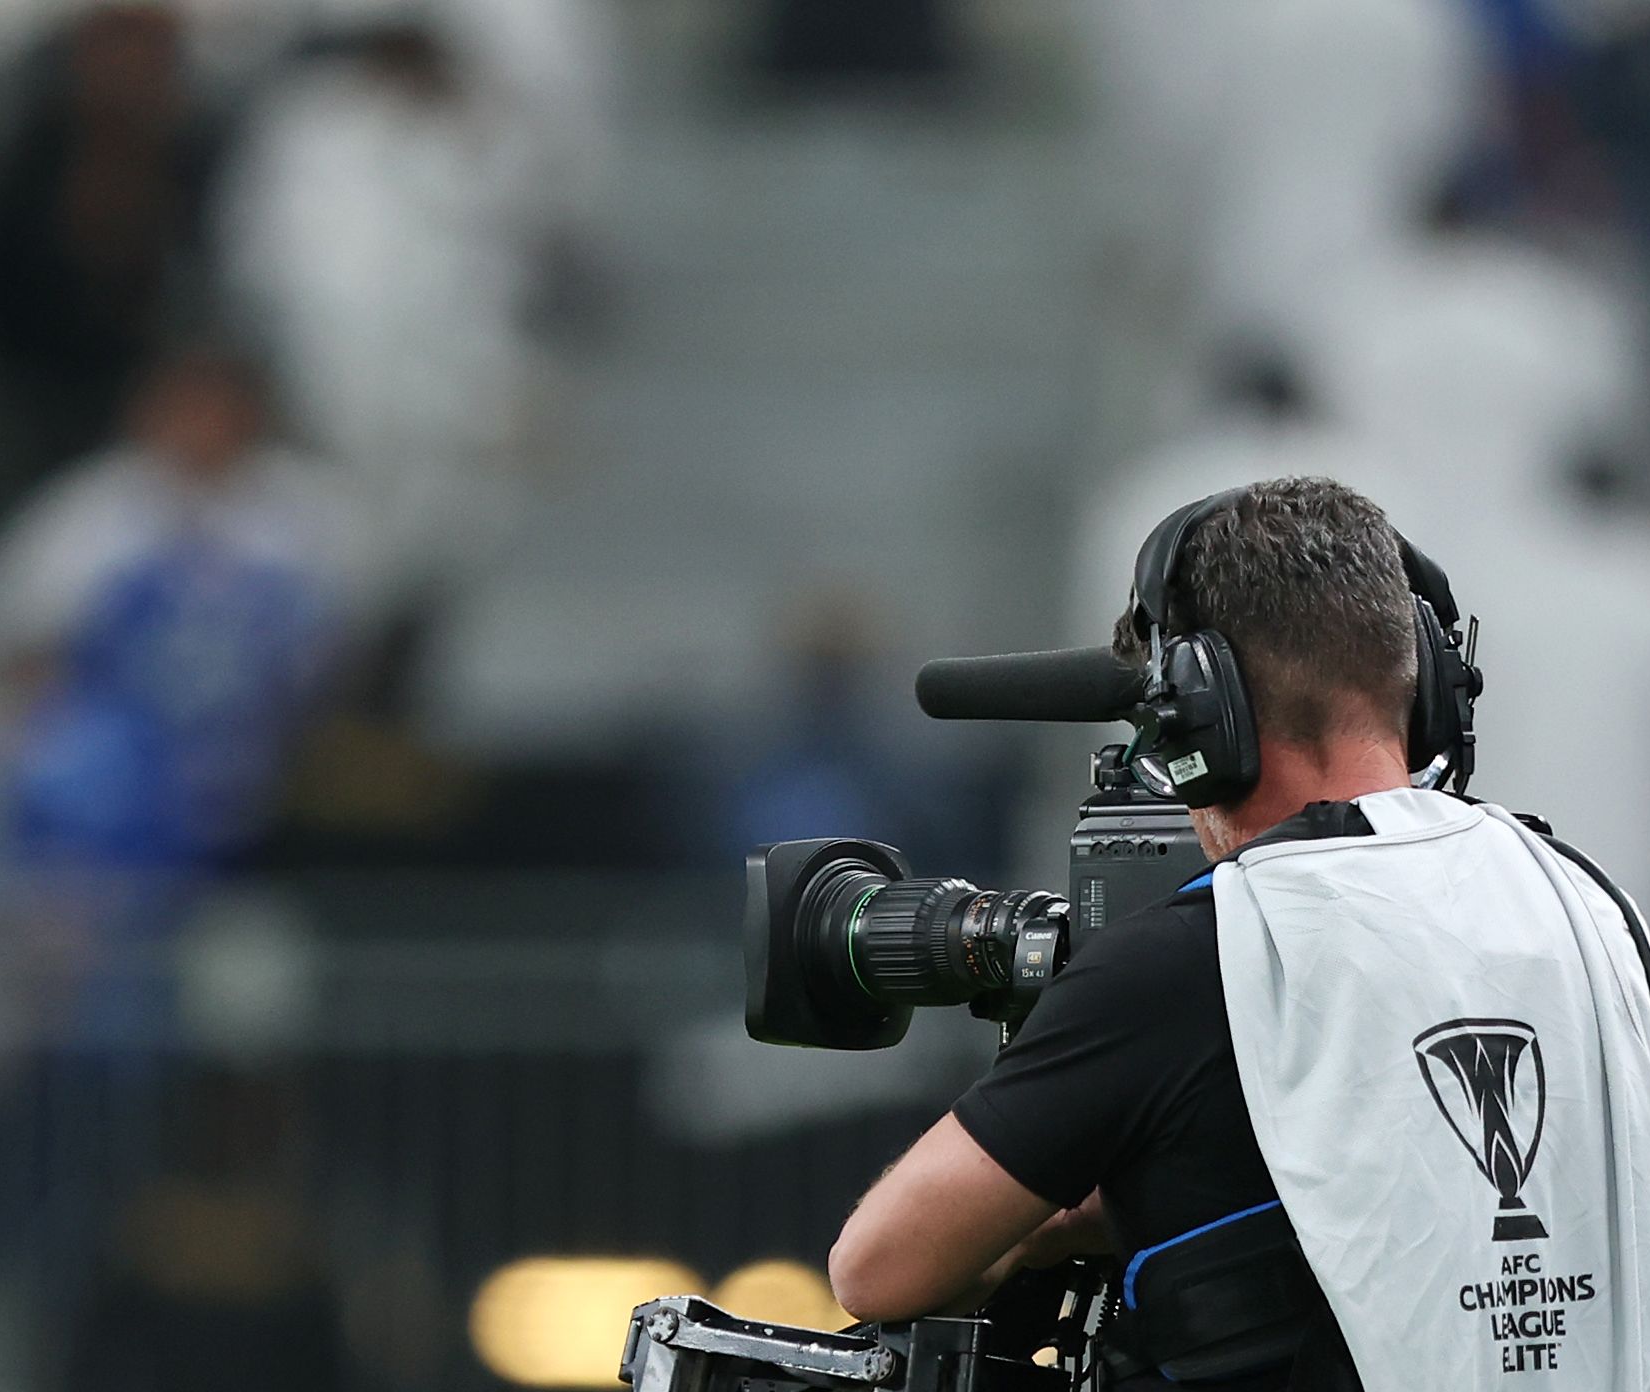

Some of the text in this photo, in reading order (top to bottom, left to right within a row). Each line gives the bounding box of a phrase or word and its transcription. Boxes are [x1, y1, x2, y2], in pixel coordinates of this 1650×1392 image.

[1025, 931, 1053, 940] Canon
[1501, 1253, 1541, 1276] AFC
[1459, 1273, 1595, 1312] CHAMPIONS
[1491, 1309, 1566, 1341] LEAGUE
[1502, 1342, 1558, 1373] ELITE
